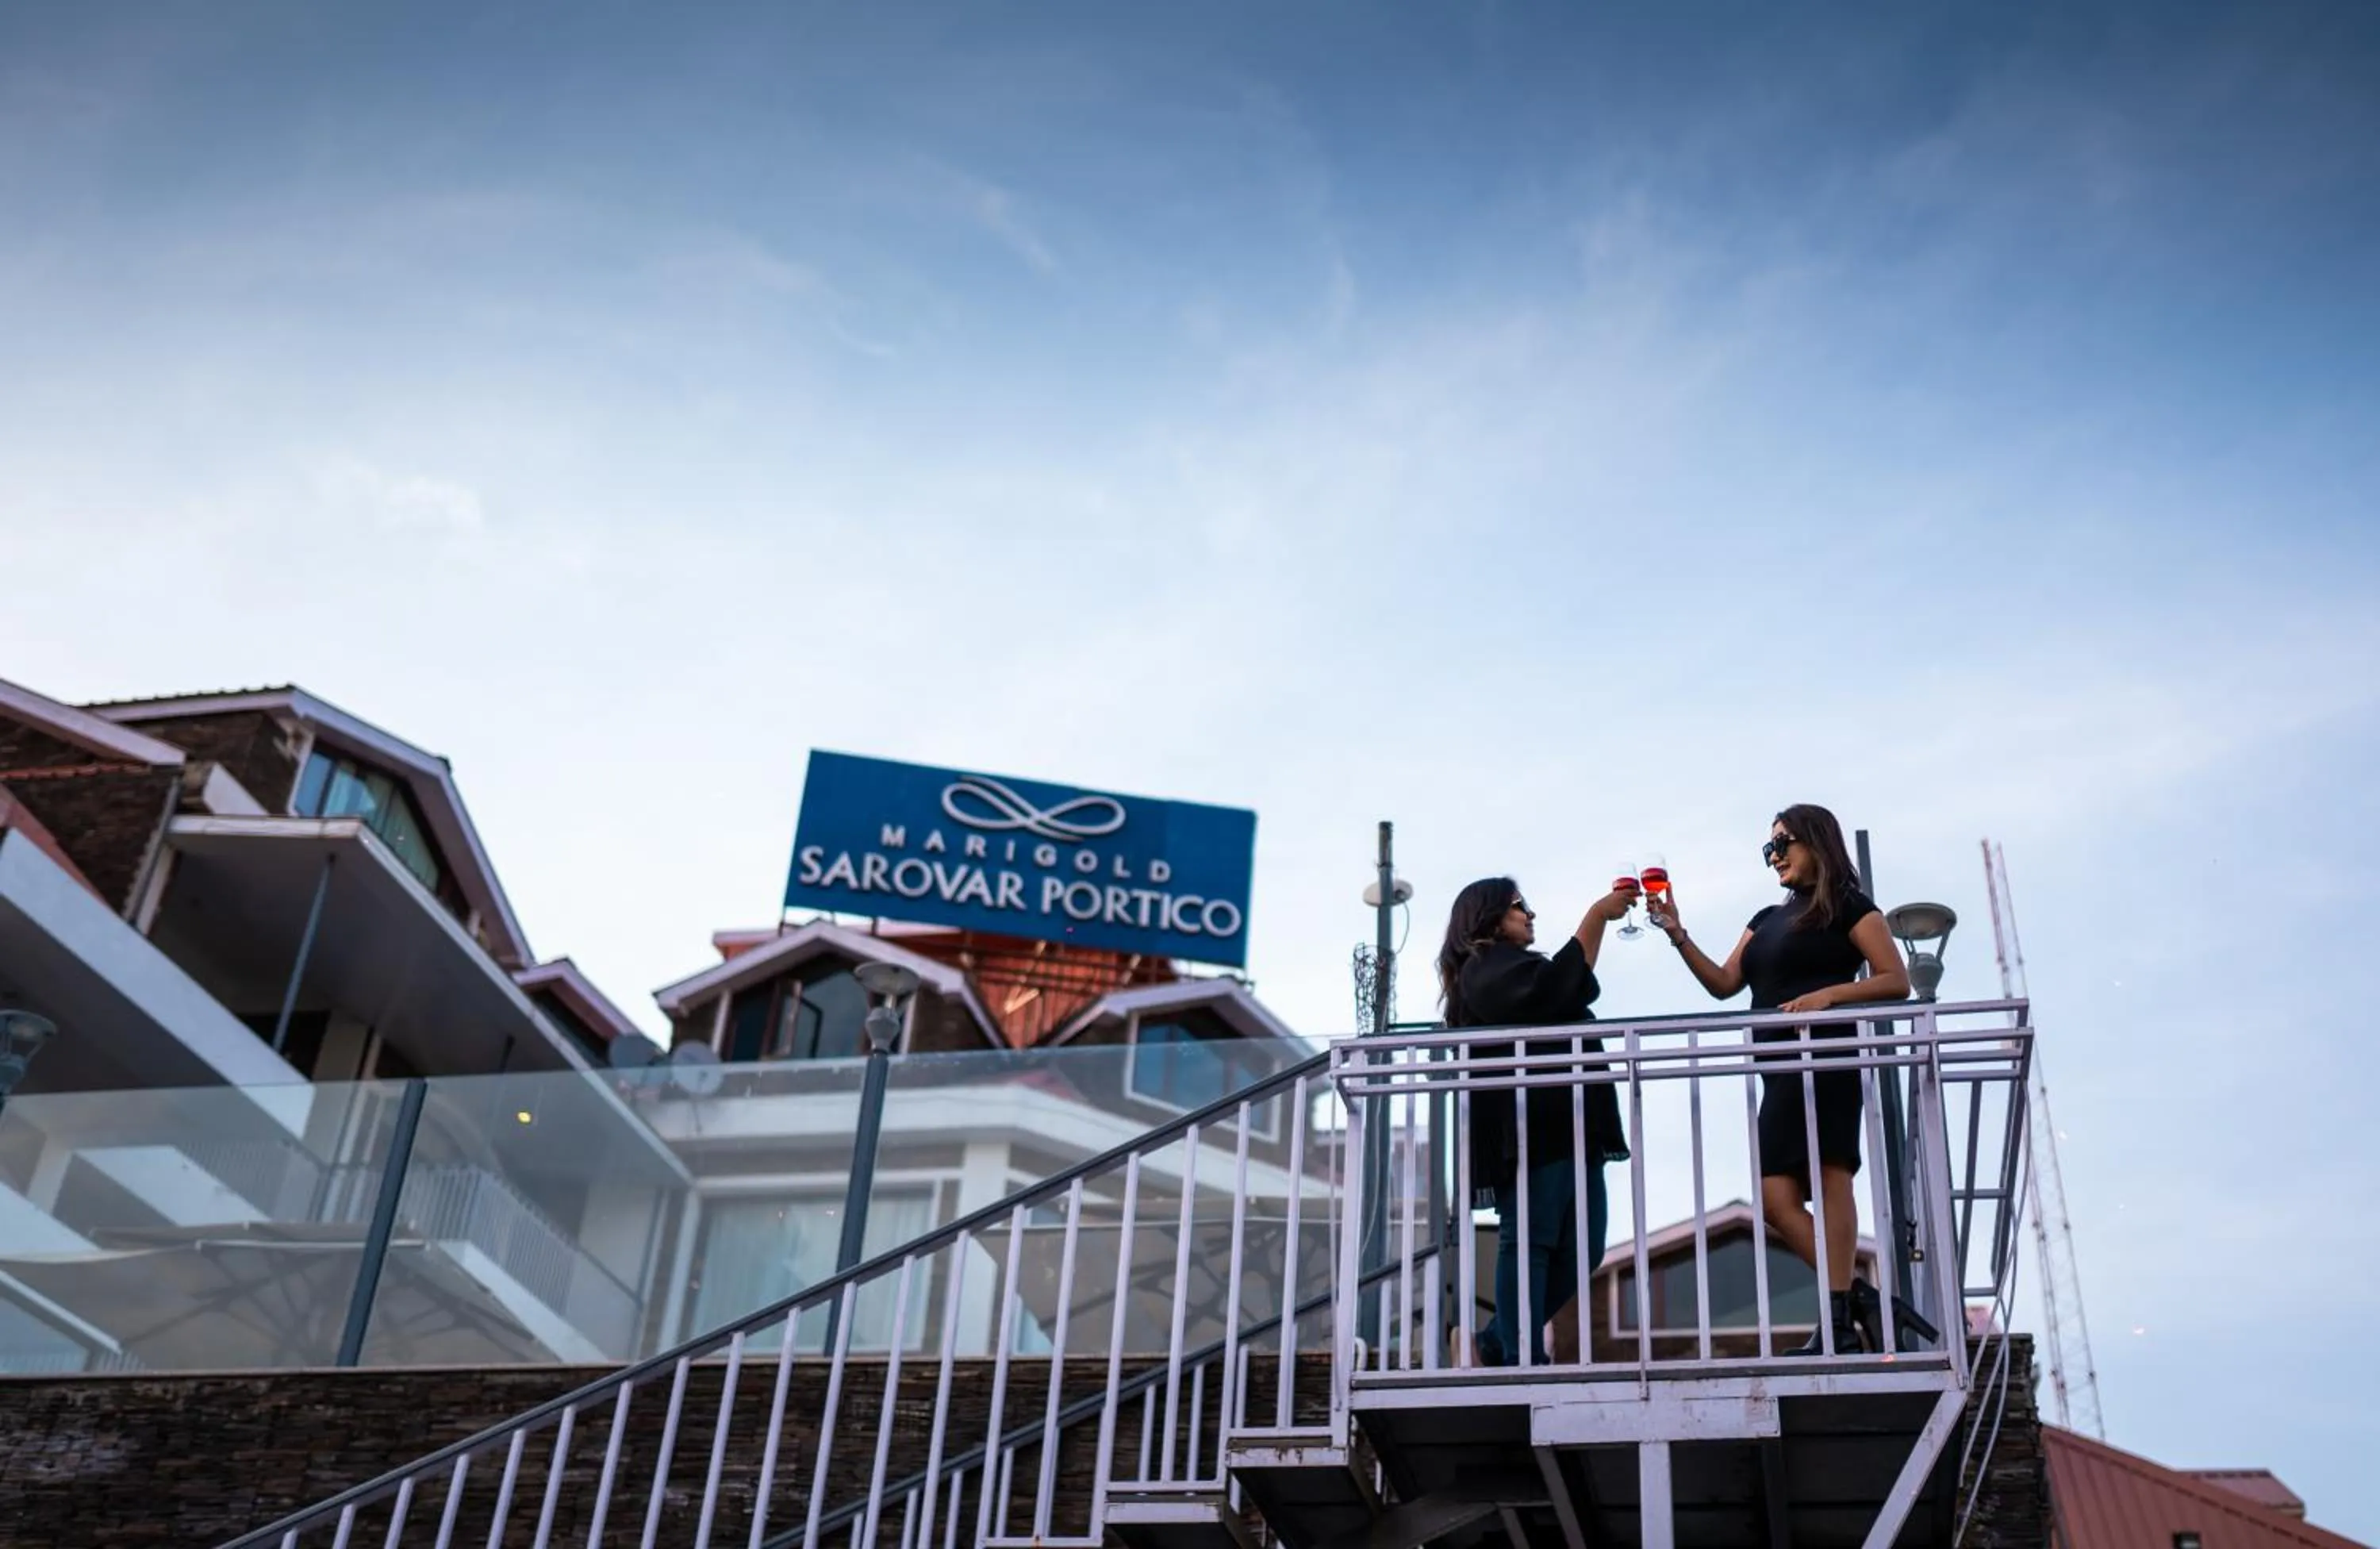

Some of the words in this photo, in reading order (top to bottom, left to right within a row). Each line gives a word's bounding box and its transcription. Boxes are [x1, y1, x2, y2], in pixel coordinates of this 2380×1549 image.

[881, 824, 1170, 882] MARIGOLD
[799, 845, 1027, 910] SAROVAR
[1041, 877, 1241, 937] PORTICO
